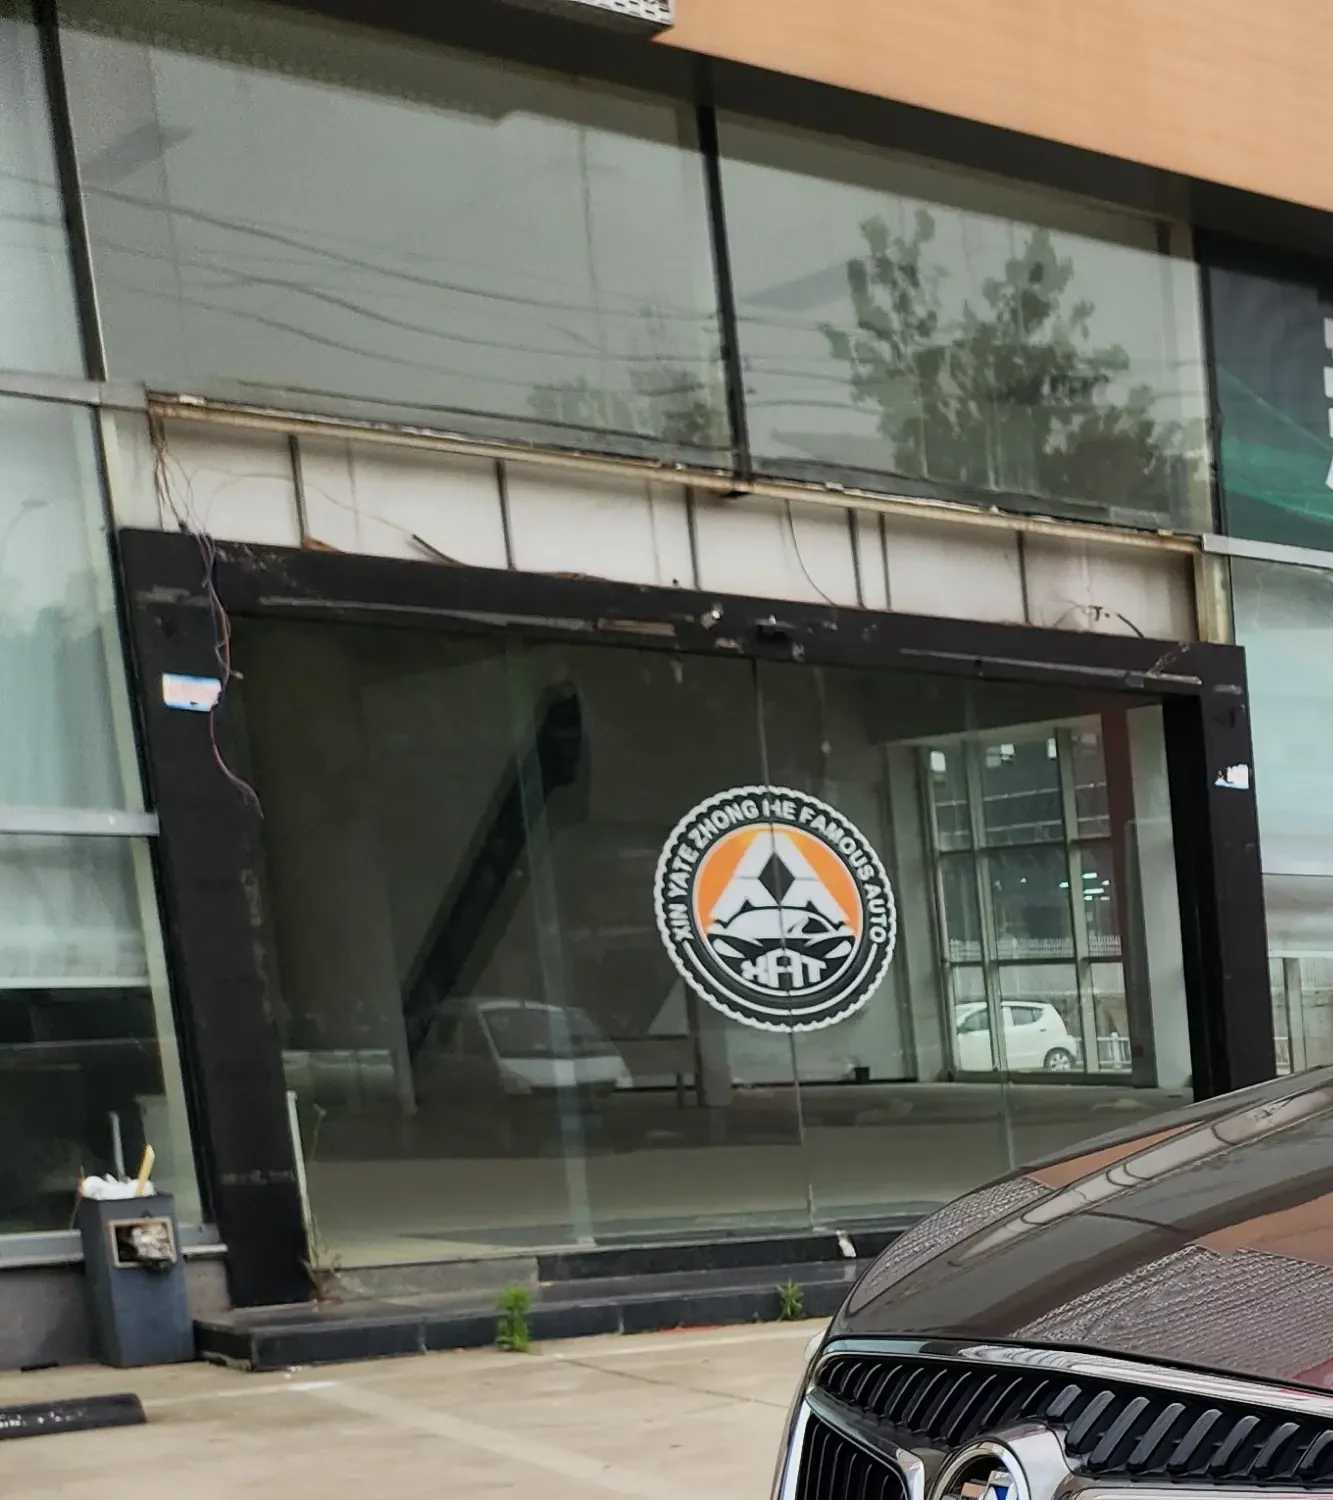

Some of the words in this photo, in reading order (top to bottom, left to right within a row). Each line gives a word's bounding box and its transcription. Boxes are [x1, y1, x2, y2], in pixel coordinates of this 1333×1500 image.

[688, 798, 759, 850] ZHONG
[761, 798, 799, 821] HE
[799, 806, 875, 881] FAMOUS
[667, 843, 700, 898] YATE
[667, 903, 694, 942] XIN
[862, 883, 889, 943] AUTO
